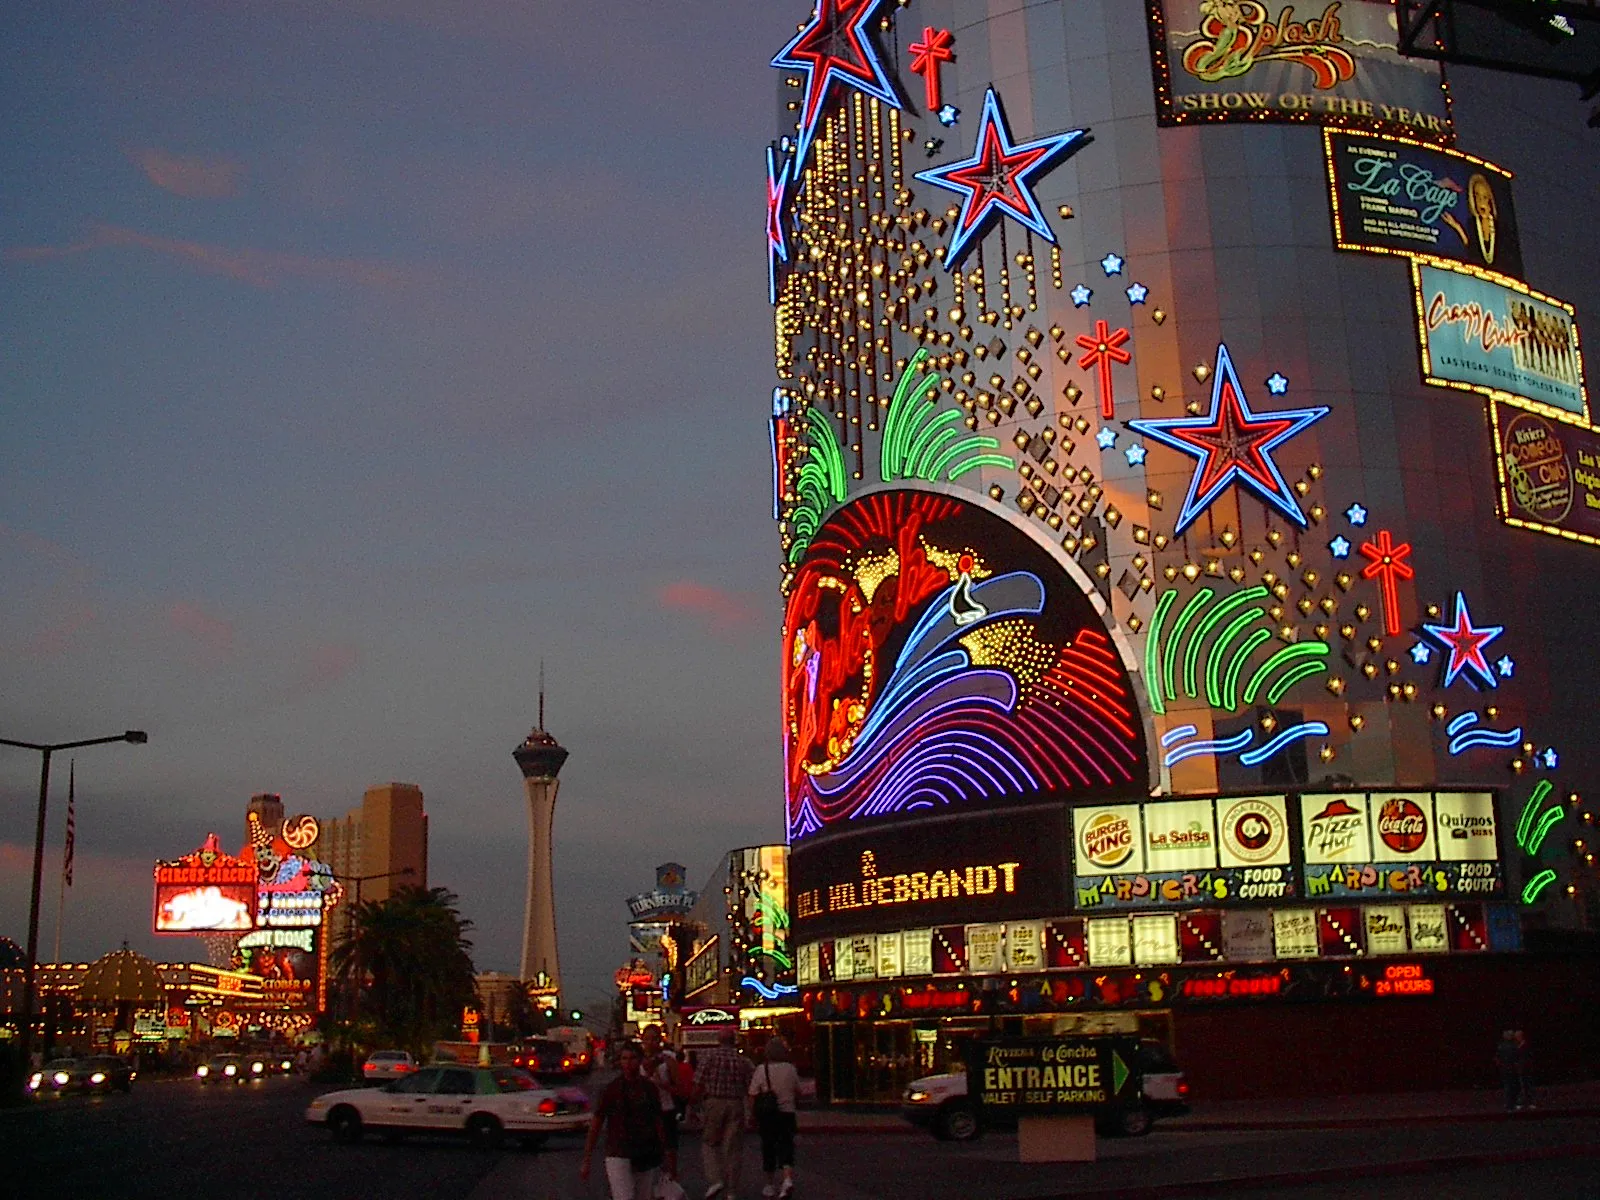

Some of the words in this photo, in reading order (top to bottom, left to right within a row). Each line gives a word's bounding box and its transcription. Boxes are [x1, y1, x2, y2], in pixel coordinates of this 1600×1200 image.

[1279, 92, 1315, 110] OF
[1322, 95, 1373, 118] THE
[1347, 158, 1401, 196] La
[1400, 163, 1458, 224] Cage
[1428, 291, 1482, 344] Crazy
[1440, 356, 1458, 367] LAS
[1438, 812, 1493, 828] Quiznos
[1085, 819, 1128, 842] BURGER
[1149, 831, 1167, 844] La
[1169, 829, 1210, 843] Salsa
[1308, 815, 1364, 848] Pizza
[1088, 830, 1132, 858] KING
[1318, 831, 1357, 853] Hut
[1243, 867, 1282, 883] FOOD
[1460, 863, 1492, 877] FOOD
[829, 862, 1020, 911] HILDEBRANDT
[1239, 883, 1287, 898] COURT
[1457, 877, 1496, 892] COURT
[274, 930, 314, 951] DOME
[1385, 966, 1421, 979] OPEN
[1376, 983, 1391, 994] 24
[1393, 979, 1432, 993] HOURS
[688, 1008, 735, 1026] Riviera
[1055, 1045, 1097, 1062] Concha
[984, 1064, 1101, 1089] ENTRANCE
[981, 1092, 1017, 1104] VALET
[1024, 1091, 1054, 1103] SELF
[1057, 1090, 1105, 1103] PARKING
